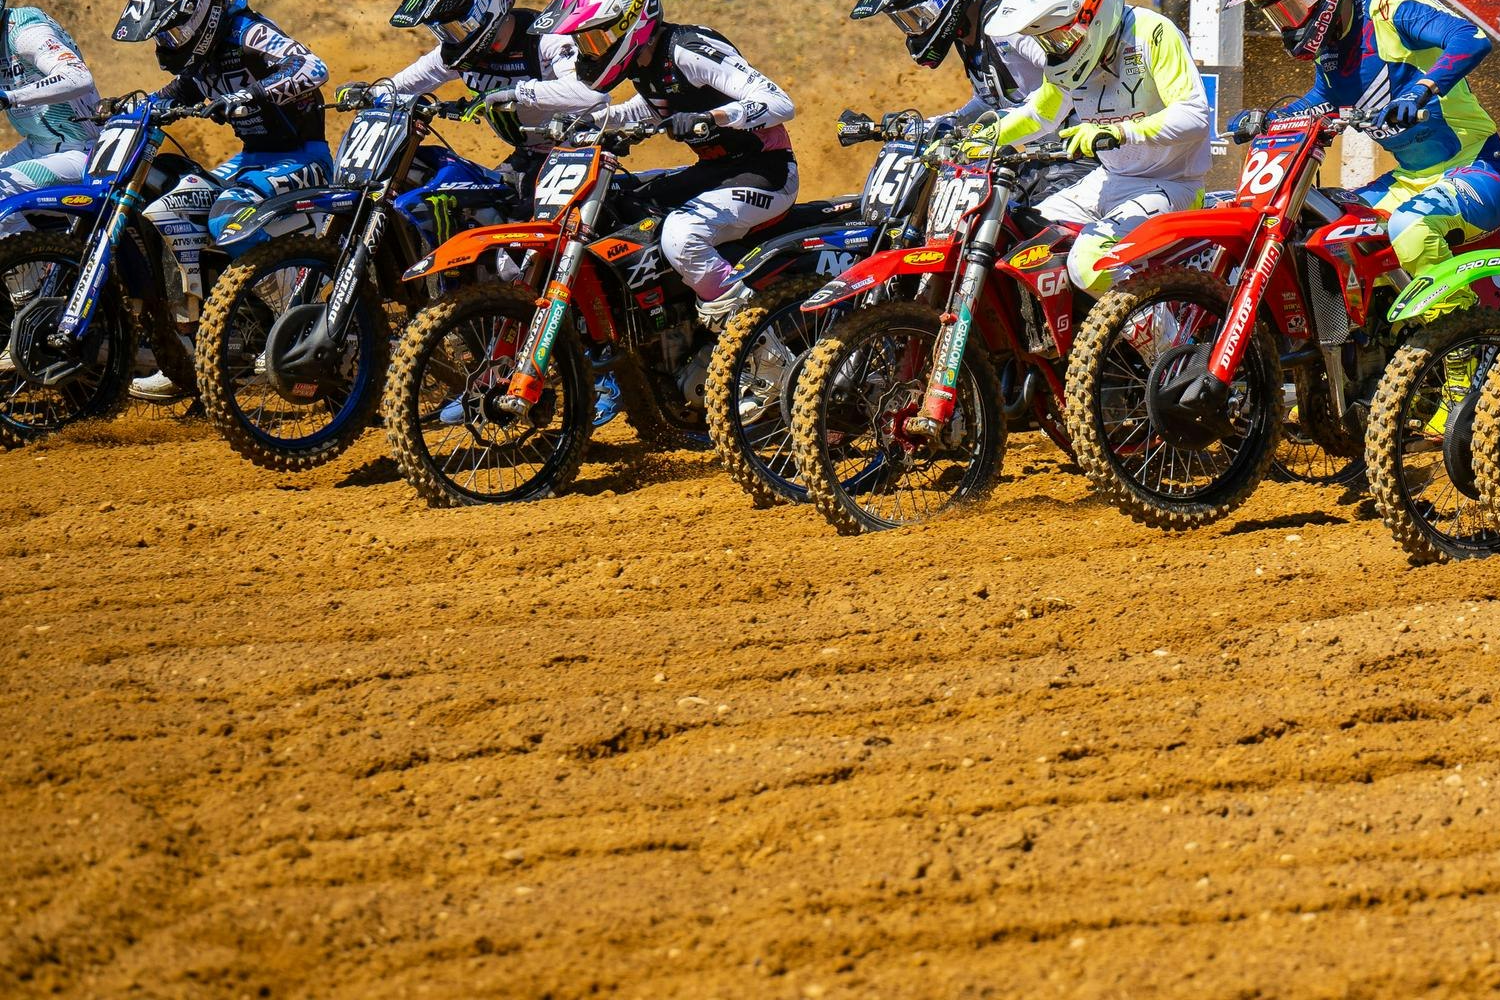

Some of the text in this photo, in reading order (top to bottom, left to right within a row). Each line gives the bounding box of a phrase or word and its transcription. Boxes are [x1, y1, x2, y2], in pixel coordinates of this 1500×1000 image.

[1271, 120, 1310, 131] RENTHAL
[88, 127, 136, 174] 71
[535, 163, 587, 206] 42
[1238, 150, 1291, 195] 96
[168, 189, 212, 209] Muc-Off
[732, 189, 774, 210] SHOT
[607, 243, 629, 259] KTM
[904, 250, 945, 265] FMF
[1010, 244, 1053, 269] FMF
[1456, 258, 1485, 274] PRO
[328, 257, 357, 325] DUNLOP
[852, 275, 875, 289] VERTEX
[543, 304, 565, 349] MOTOREX
[1220, 297, 1253, 370] DUNLOP
[949, 318, 970, 370] MOTOREX
